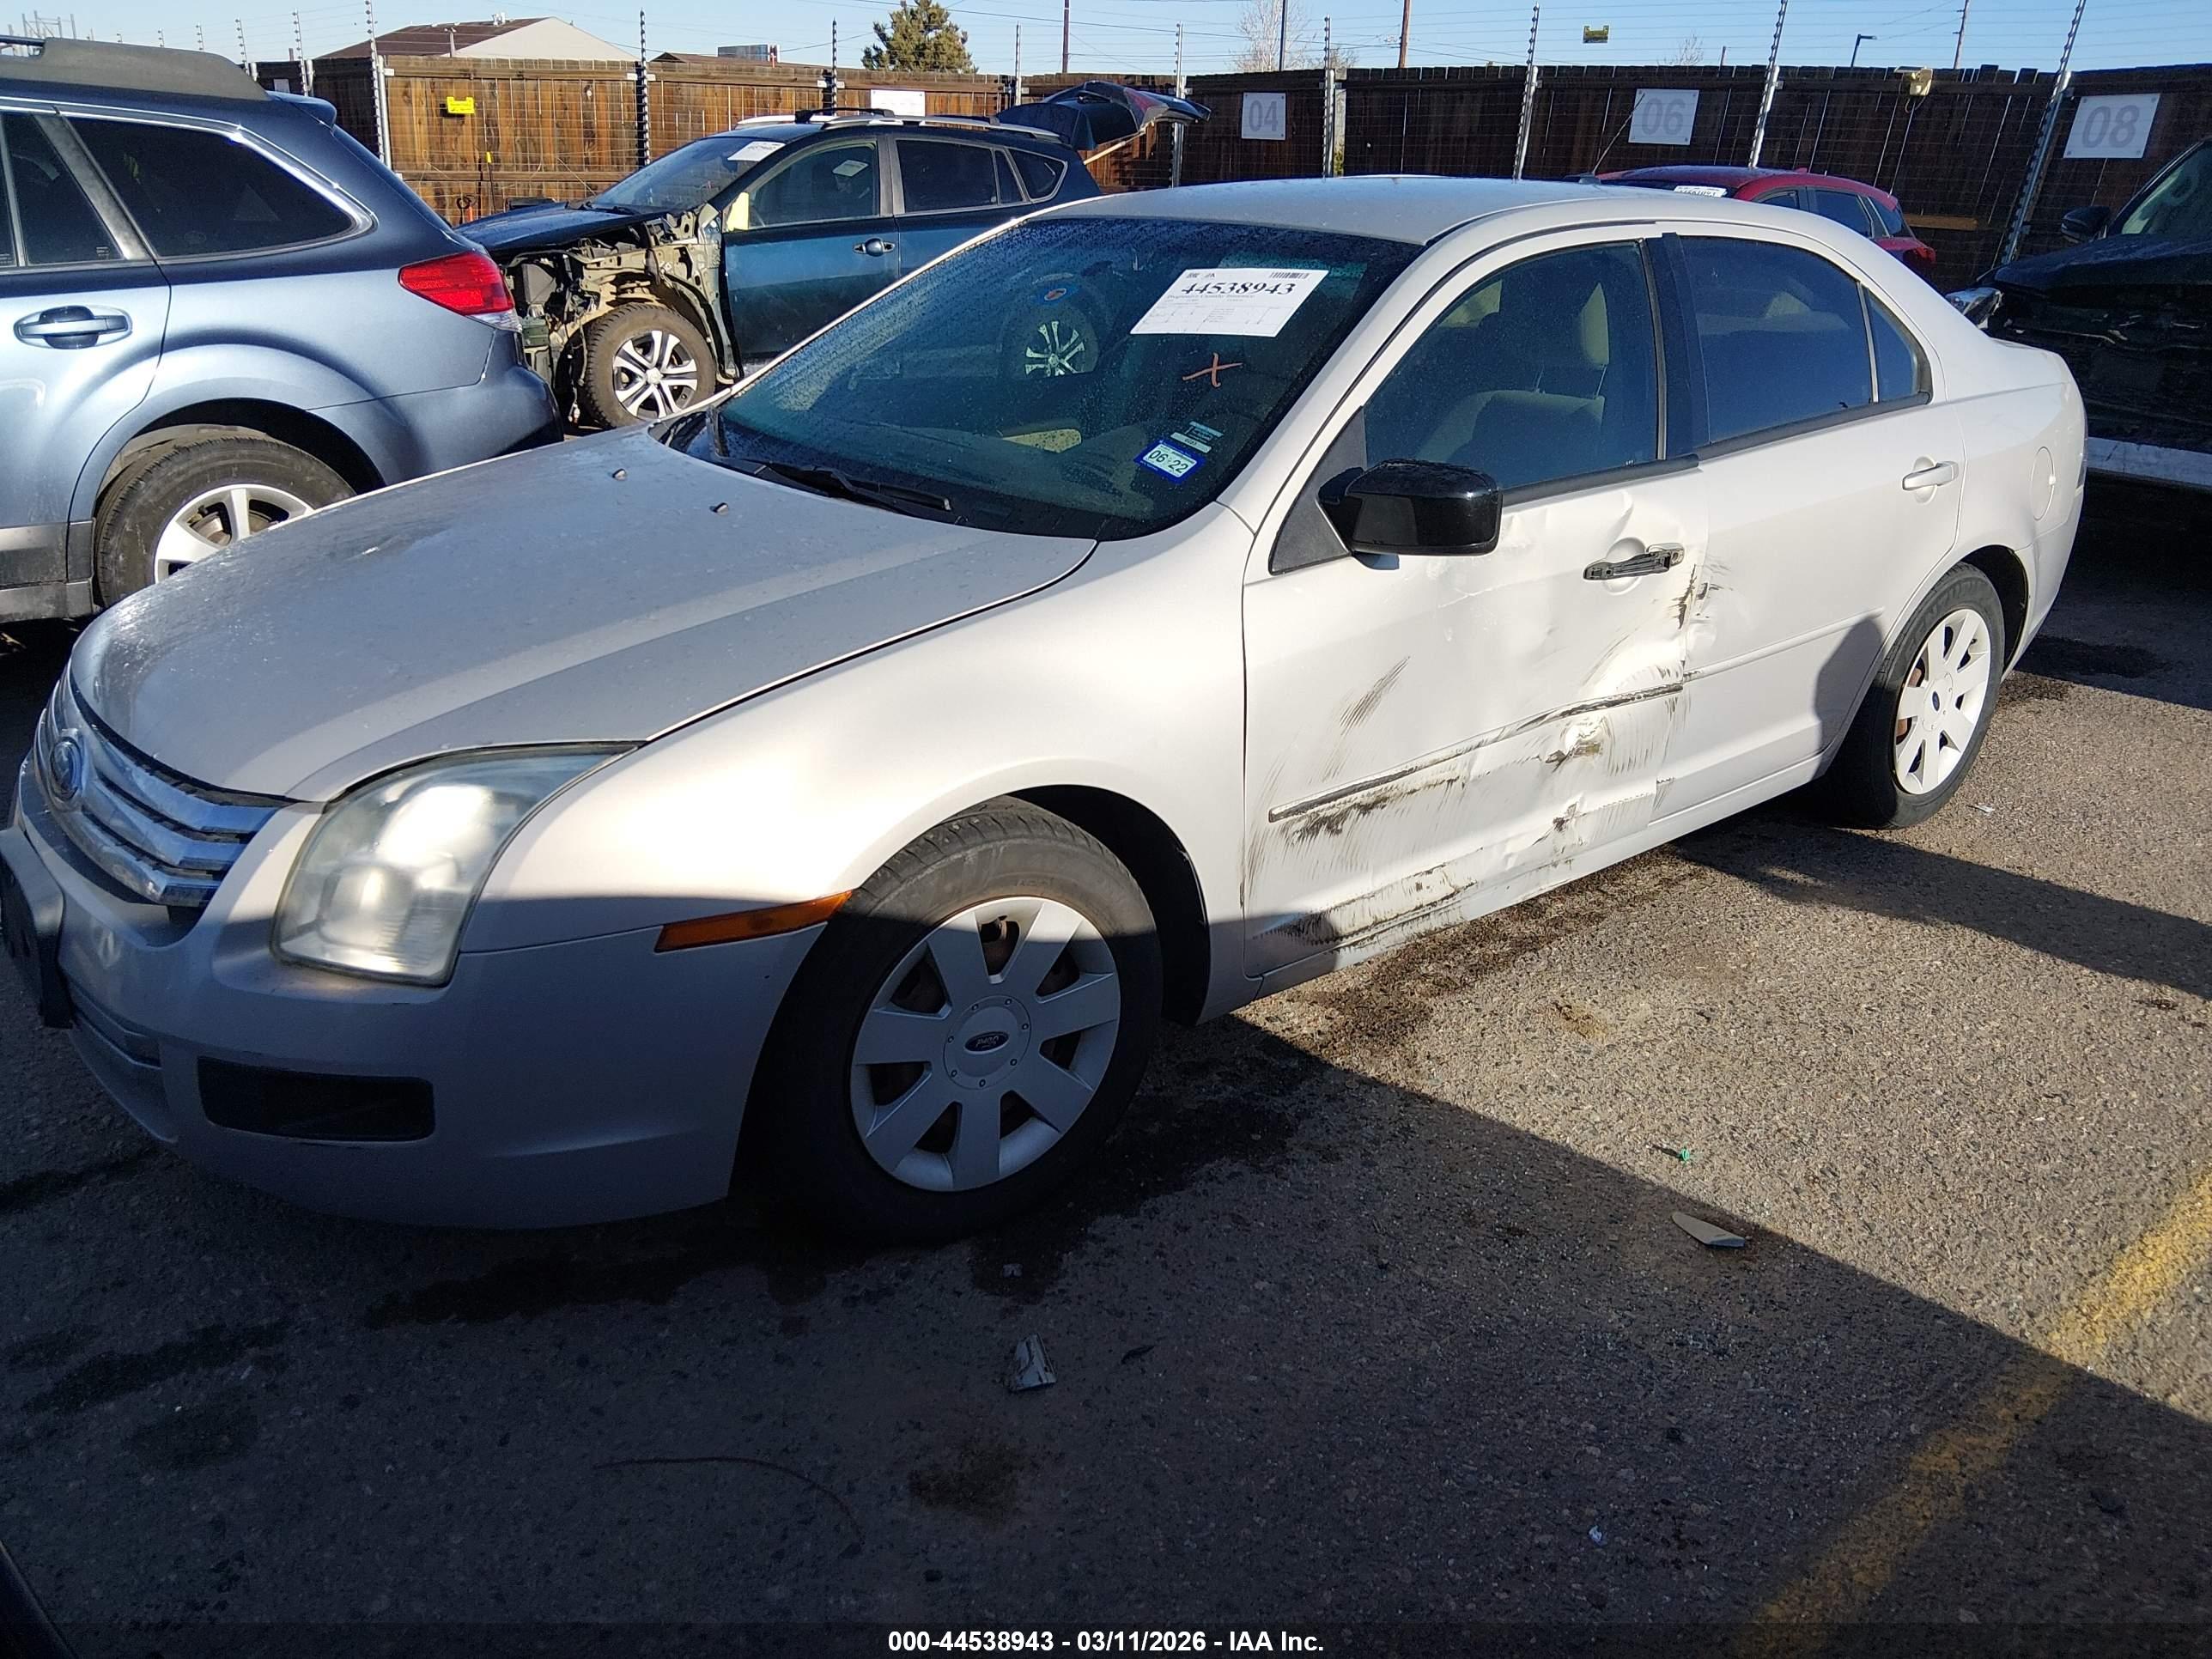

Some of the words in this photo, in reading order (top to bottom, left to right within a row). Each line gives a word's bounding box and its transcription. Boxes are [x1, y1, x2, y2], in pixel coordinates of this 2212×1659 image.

[1249, 100, 1279, 131] 04
[1641, 97, 1686, 136] 06
[2081, 105, 2140, 149] 08
[1182, 282, 1295, 295] 44538943
[1149, 450, 1169, 463] 06
[1169, 459, 1188, 474] 22
